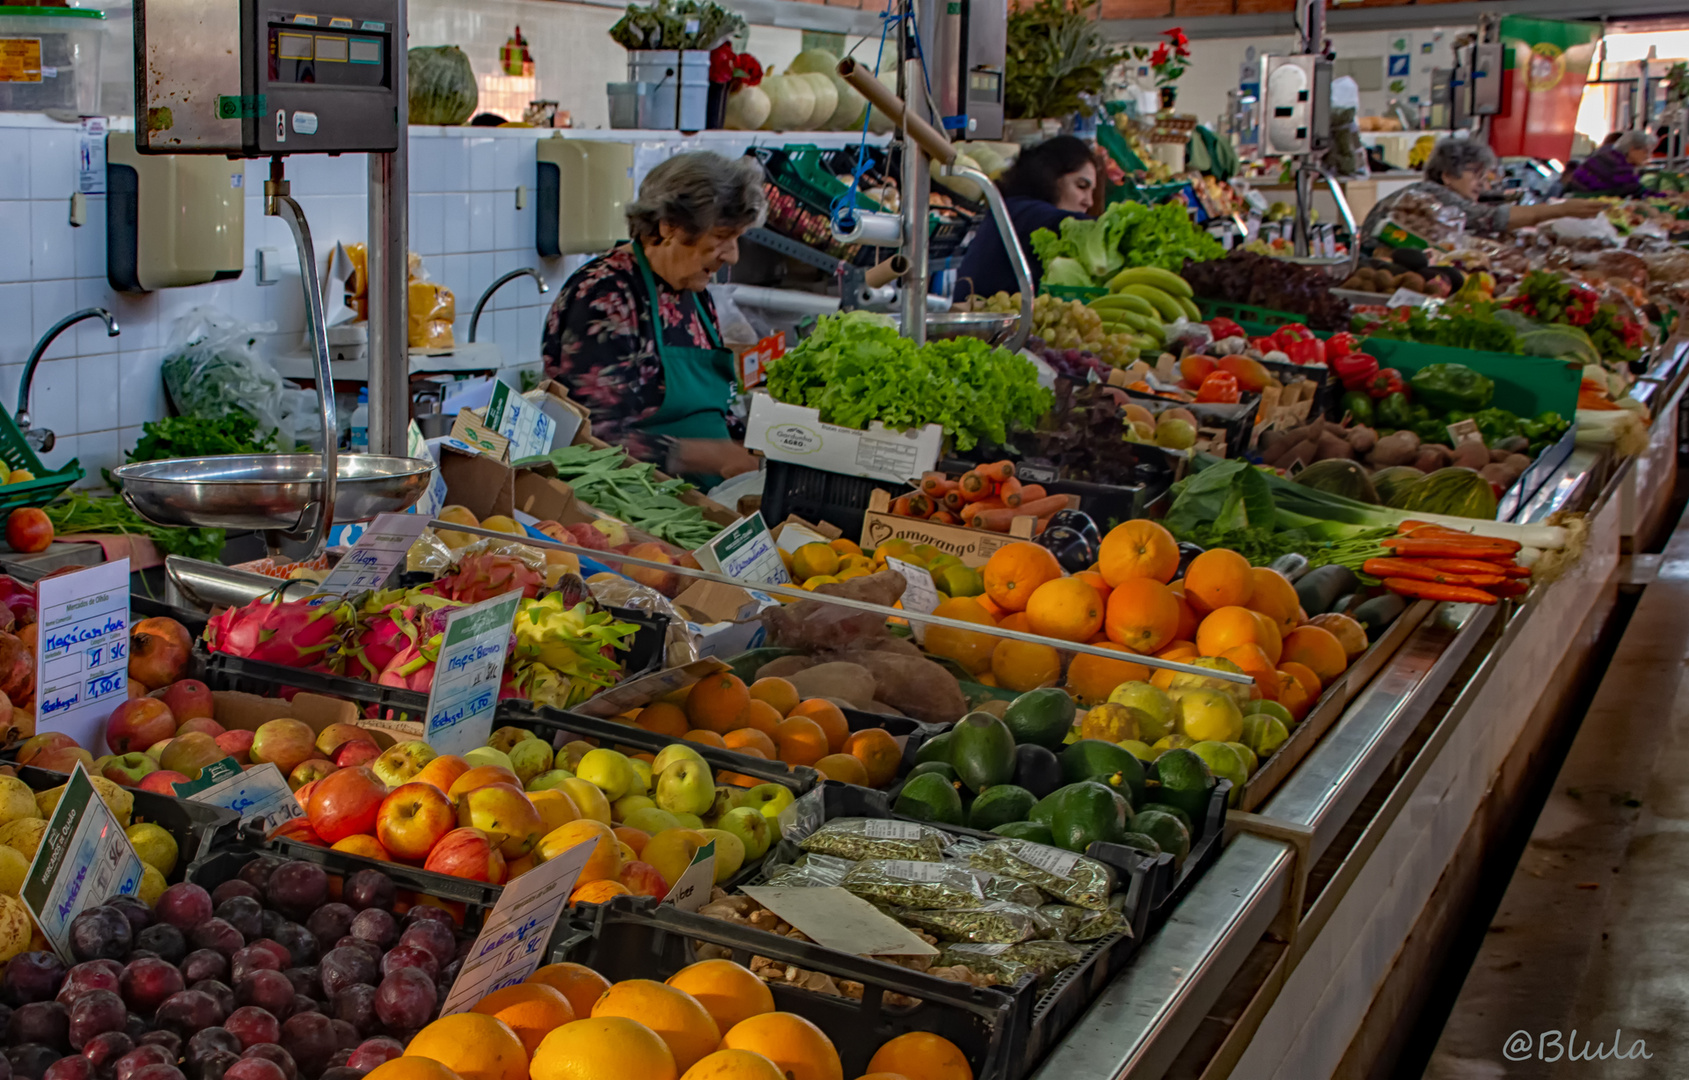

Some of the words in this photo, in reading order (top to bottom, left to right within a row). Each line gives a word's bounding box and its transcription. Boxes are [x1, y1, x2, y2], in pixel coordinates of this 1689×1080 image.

[783, 438, 804, 447] AGRO
[66, 600, 89, 612] Mercados
[88, 598, 95, 606] de
[41, 842, 62, 885] MERCADOS
[61, 808, 77, 836] OLHÃO
